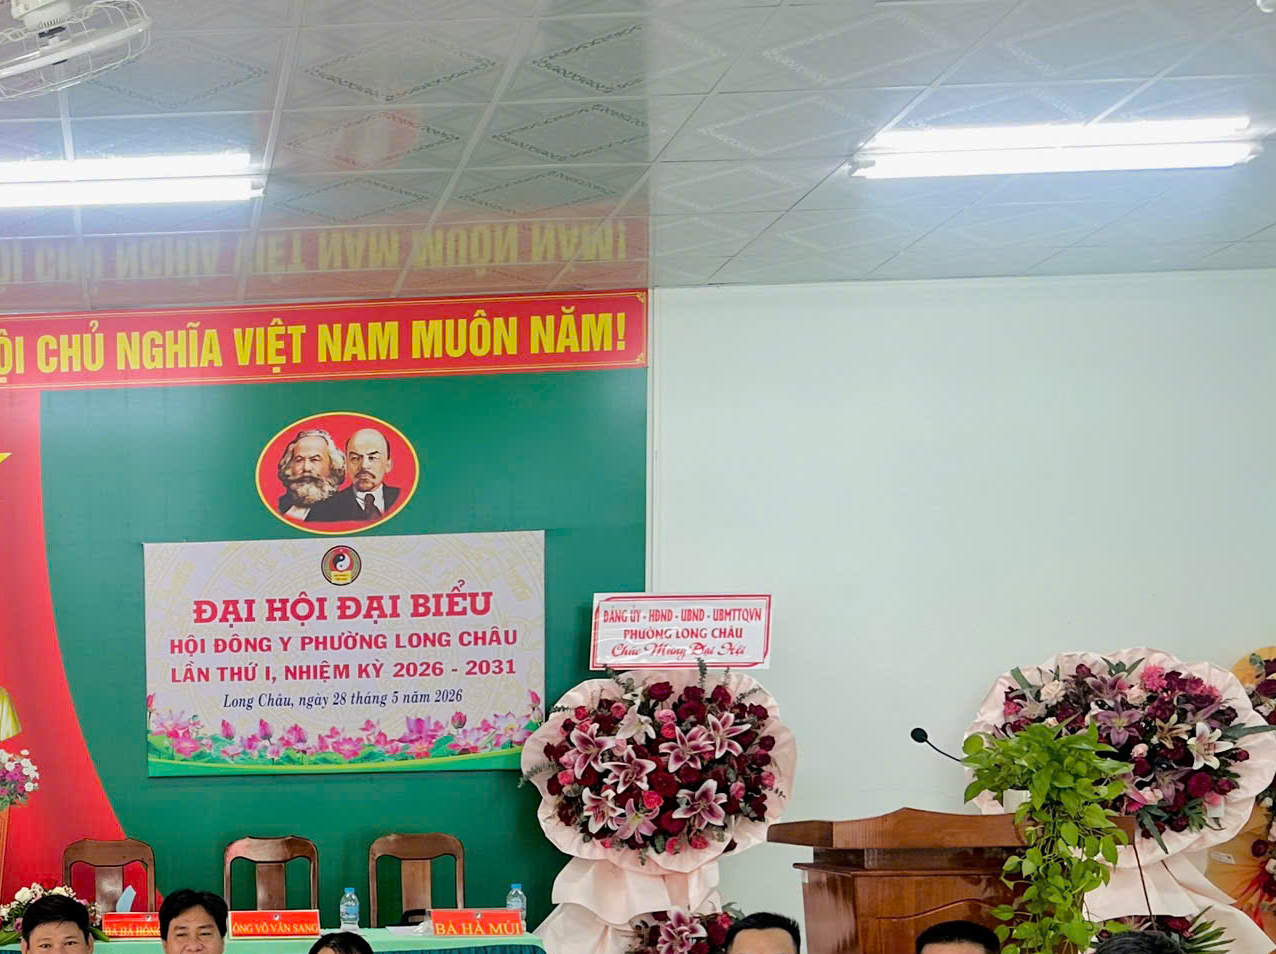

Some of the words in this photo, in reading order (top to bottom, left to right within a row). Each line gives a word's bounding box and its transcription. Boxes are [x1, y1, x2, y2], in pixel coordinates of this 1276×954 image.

[37, 320, 104, 373] CHỦ
[117, 321, 223, 370] NGHĨA
[233, 317, 306, 373] VIỆT
[318, 321, 398, 363] NAM
[412, 309, 517, 359] MUÔN
[530, 306, 626, 354] NĂM!
[193, 599, 256, 628] ĐẠI
[265, 591, 327, 627] HỘI
[337, 594, 400, 624] ĐẠI
[410, 579, 493, 618] BIỂU
[681, 608, 704, 622] UBND
[713, 608, 762, 623] UBMTTQVN
[170, 635, 205, 657] HỘI
[213, 633, 272, 653] ĐÔNG
[279, 636, 292, 651] Y
[301, 630, 387, 651] PHƯỜNG
[395, 632, 451, 648] LONG
[458, 626, 517, 646] CHÂU
[676, 628, 707, 639] LONG
[711, 625, 743, 639] CHÂU
[171, 660, 210, 683] LẦN
[216, 662, 259, 682] THỨ
[265, 666, 277, 684] I,
[284, 660, 350, 683] NHIỆM
[358, 659, 384, 679] KỲ
[393, 661, 444, 678] 2026
[465, 659, 516, 676] 2031
[224, 694, 254, 710] Long
[258, 693, 294, 708] Châu,
[299, 693, 329, 709] ngày
[333, 692, 347, 706] 28
[351, 691, 388, 707] tháng
[391, 690, 399, 704] 5
[403, 690, 430, 703] năm
[434, 689, 463, 703] 2026
[233, 922, 252, 933] ÔNG
[293, 923, 318, 933] SANG
[435, 920, 458, 935] BÀ
